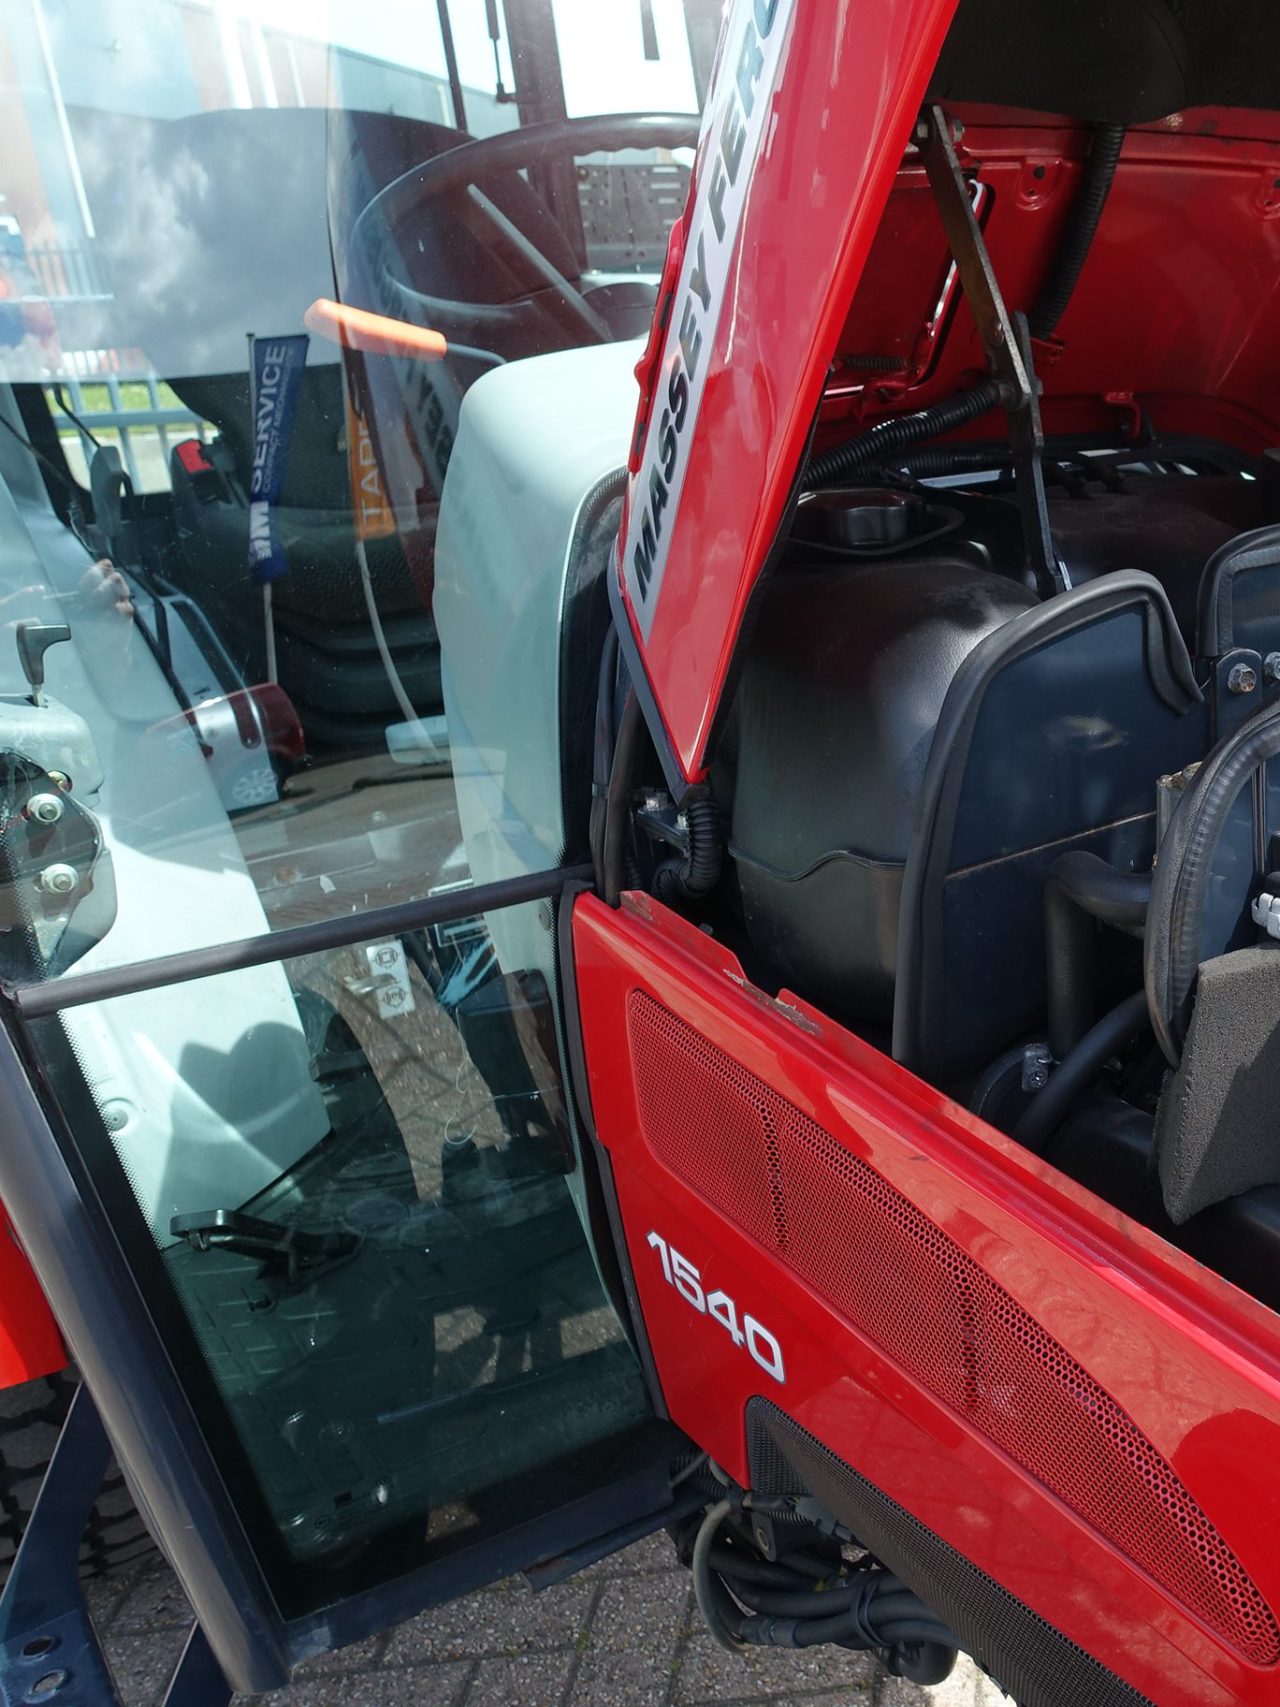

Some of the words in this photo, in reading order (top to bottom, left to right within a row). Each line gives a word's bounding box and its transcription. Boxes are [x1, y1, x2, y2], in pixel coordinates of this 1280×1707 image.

[251, 345, 287, 494] SERVICE
[633, 232, 712, 603] MASSEY
[646, 1231, 786, 1384] 1540
